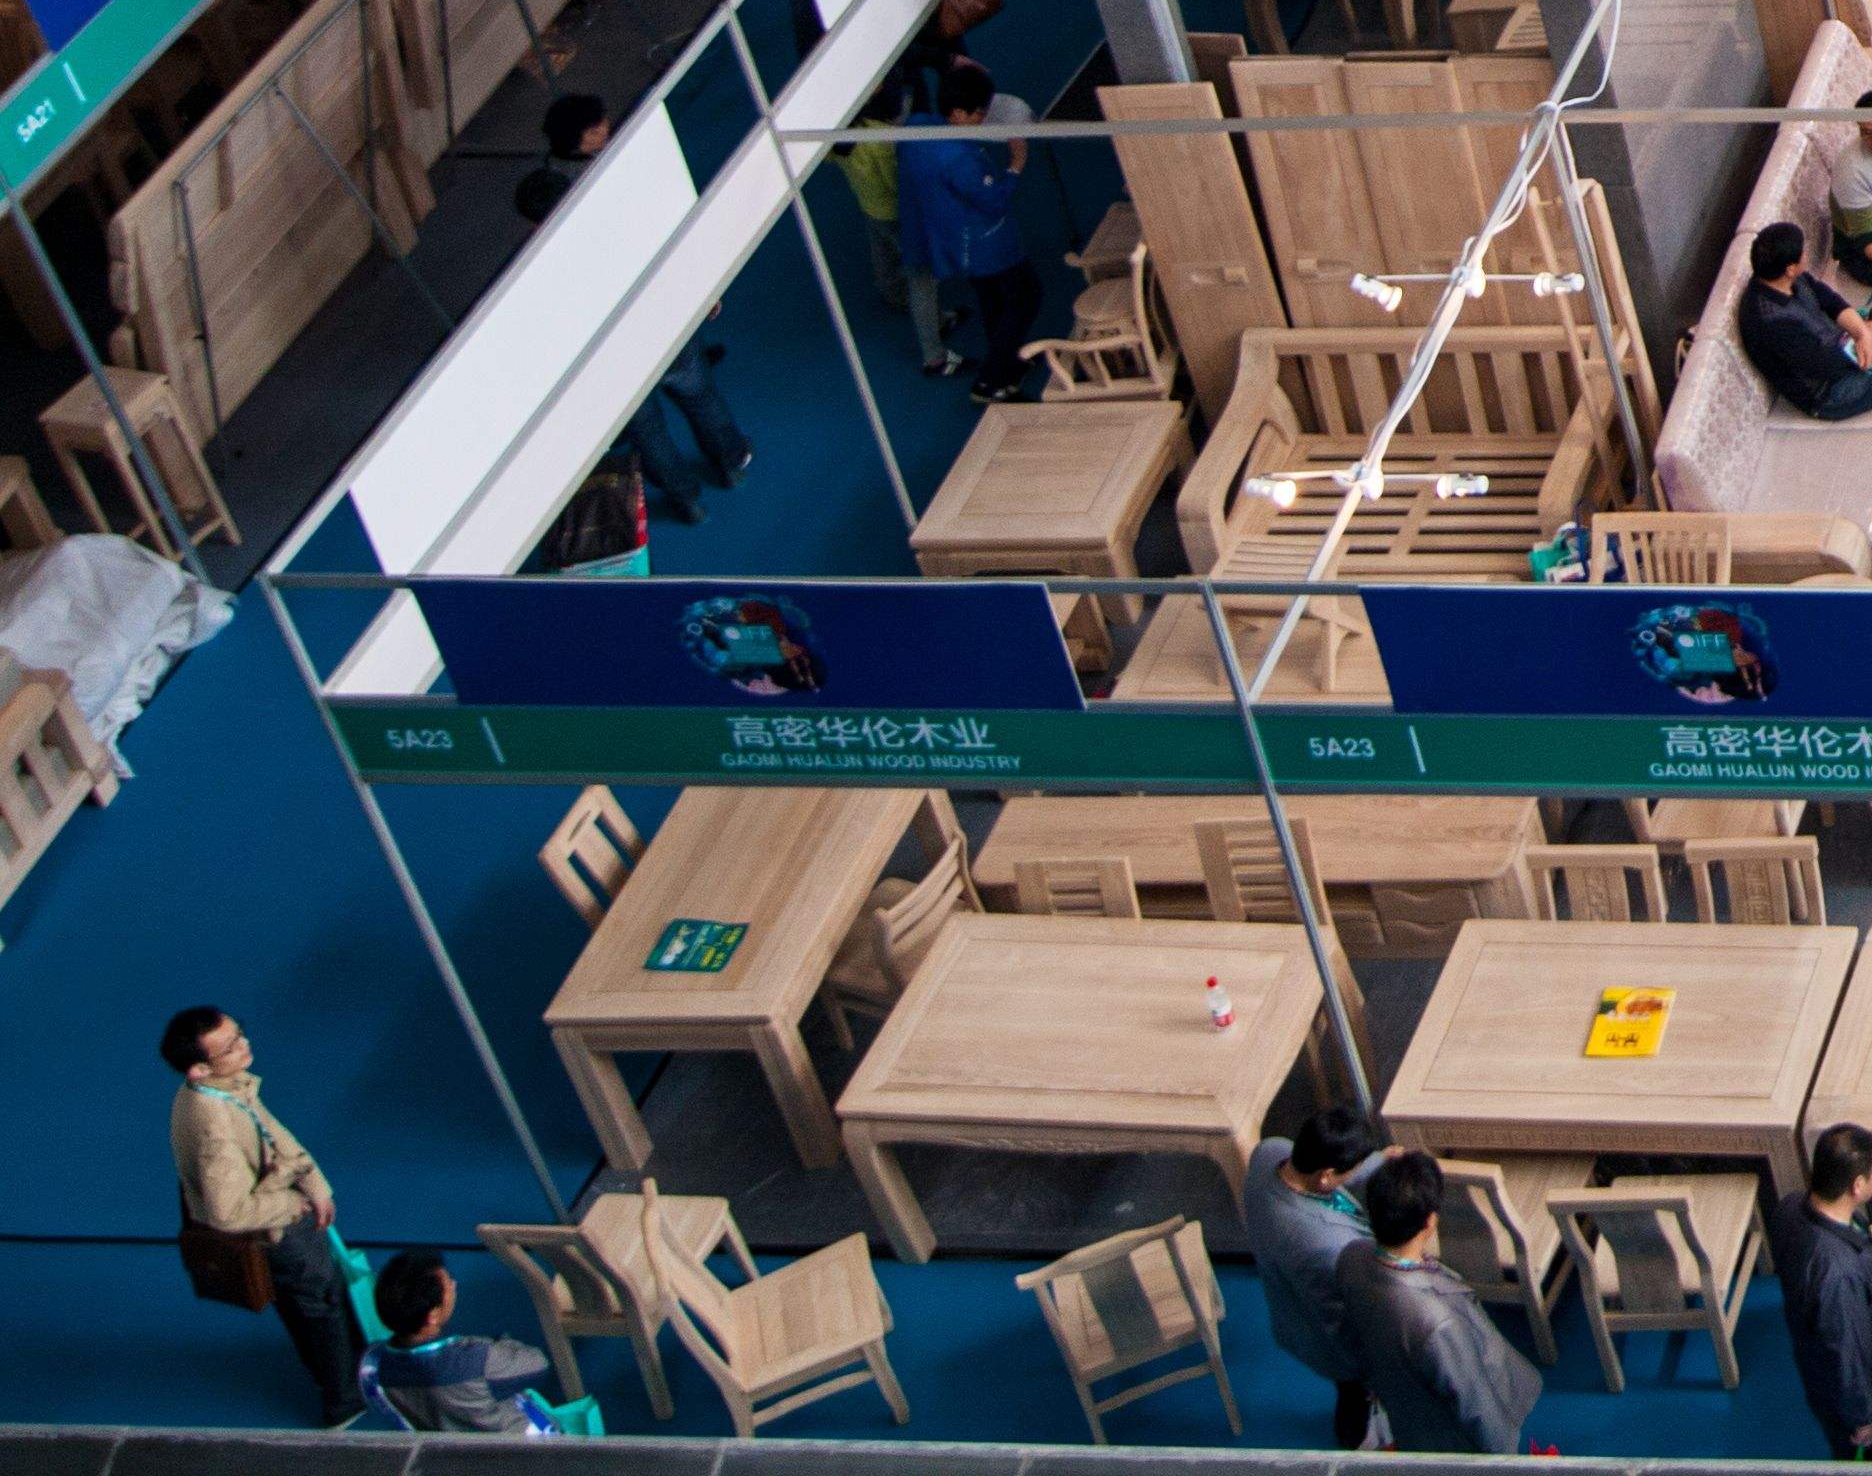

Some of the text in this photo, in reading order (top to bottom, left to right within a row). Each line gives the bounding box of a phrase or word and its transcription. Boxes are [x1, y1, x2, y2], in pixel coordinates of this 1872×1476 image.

[387, 728, 454, 749] 5A23
[726, 715, 996, 748] 高密华伦木业
[1309, 737, 1376, 758] 5A23
[721, 752, 783, 768] GAOMI
[868, 754, 927, 769] WOOD
[931, 754, 1021, 770] INDUSTRY
[1650, 762, 1713, 778] GAOMI
[1718, 763, 1796, 779] HUALUN
[1802, 764, 1860, 780] WOOD
